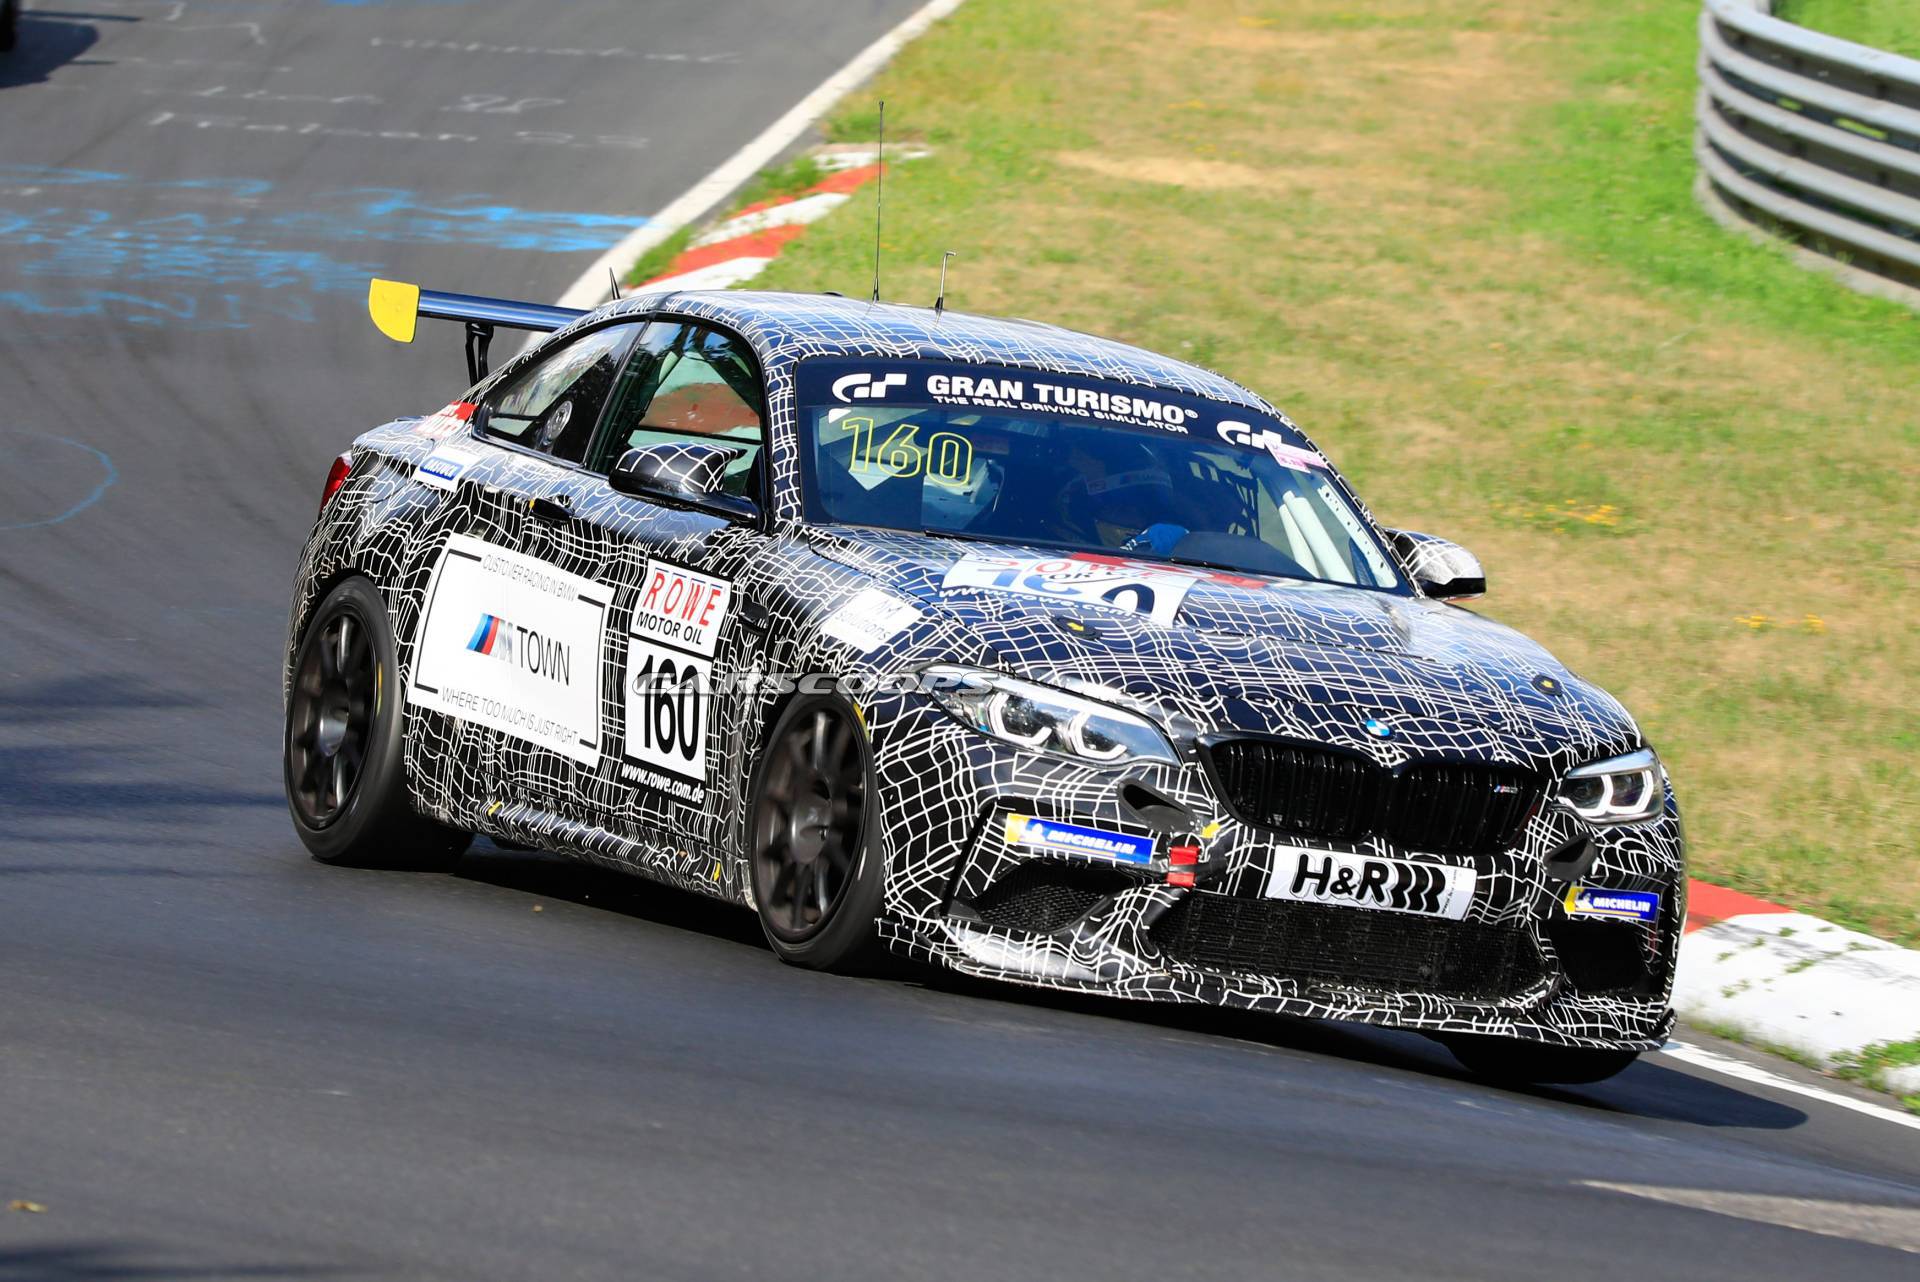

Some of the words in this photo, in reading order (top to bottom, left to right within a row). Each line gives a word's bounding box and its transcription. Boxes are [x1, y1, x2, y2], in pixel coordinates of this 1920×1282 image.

[927, 375, 1023, 400] GRAN
[933, 395, 968, 406] THE
[973, 397, 1018, 410] REAL
[1021, 402, 1090, 418] DRIVING
[1093, 409, 1189, 435] SIMULATOR
[842, 416, 973, 487] 160
[482, 554, 524, 582] CUSTOMER
[522, 568, 551, 592] RACING
[556, 581, 578, 602] BMW
[643, 572, 722, 627] ROWE
[636, 611, 681, 639] MOTOR
[683, 625, 703, 646] OIL
[516, 625, 570, 687] TOWN
[442, 686, 480, 711] WHERE
[481, 697, 501, 719] TOO
[500, 704, 528, 728] MUCH
[534, 719, 556, 736] JUST
[553, 723, 578, 746] RIGHT
[637, 654, 700, 762] 160
[620, 763, 705, 805] www.rowe.com.de
[1047, 829, 1137, 855] MICHELIN
[1593, 896, 1651, 913] MICHELIN
